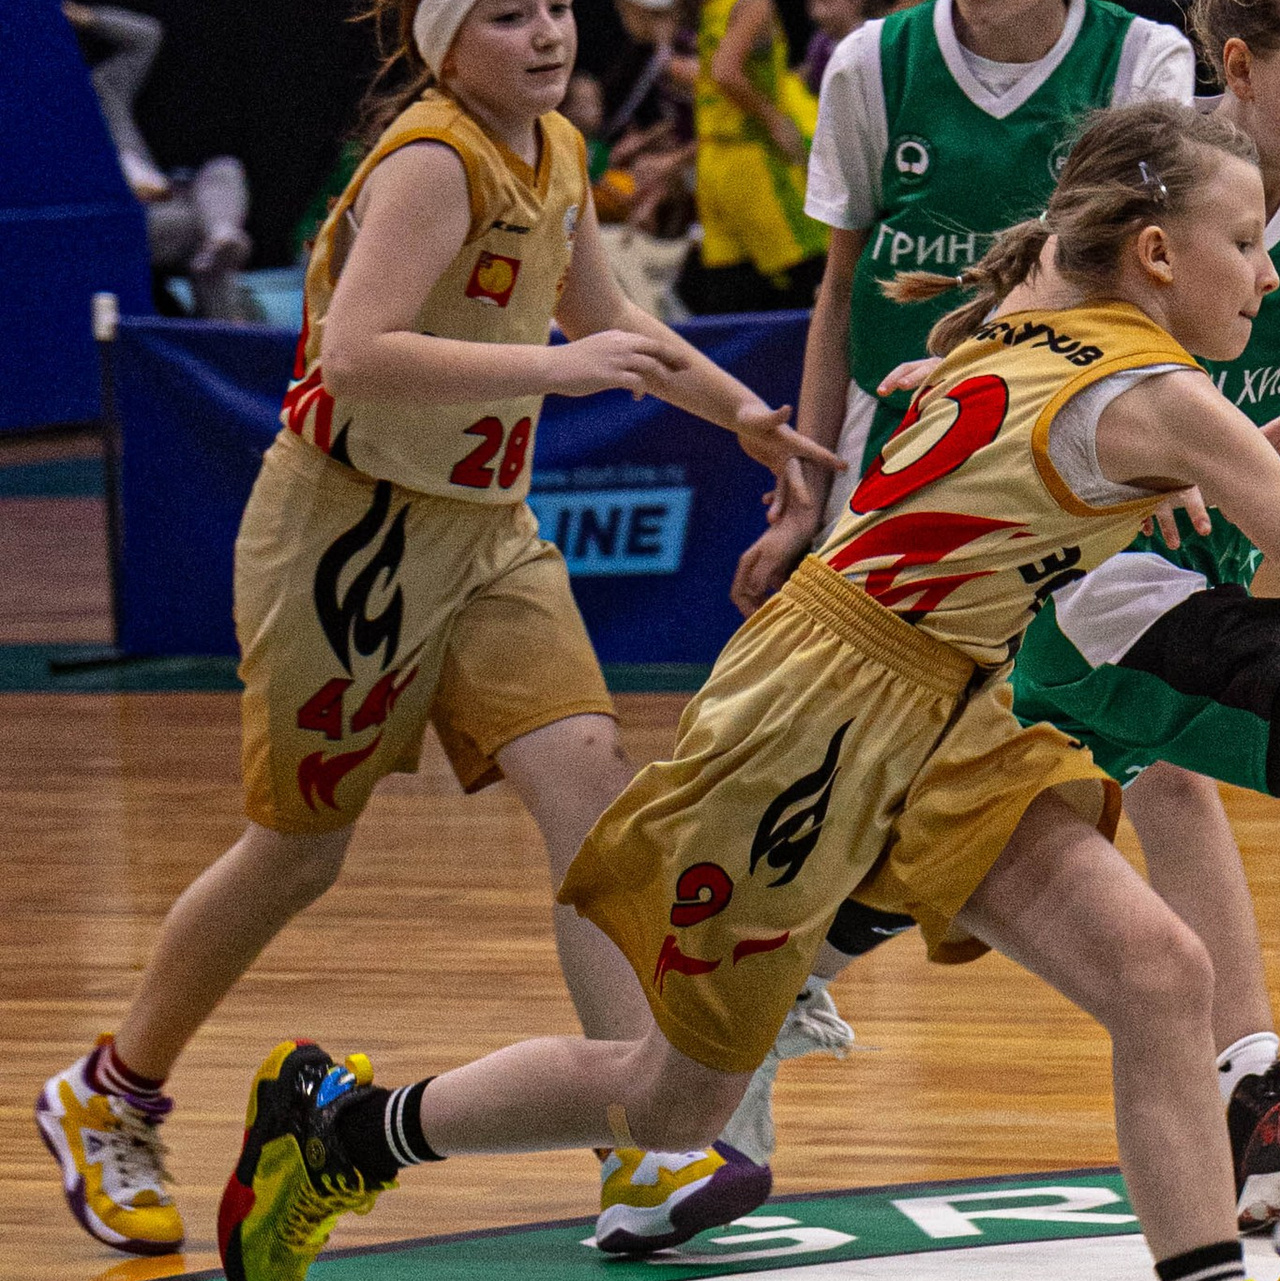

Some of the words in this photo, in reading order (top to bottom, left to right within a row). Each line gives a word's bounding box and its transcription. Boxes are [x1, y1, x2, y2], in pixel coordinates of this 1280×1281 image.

[872, 223, 976, 265] ГРИН
[450, 415, 532, 489] 28
[556, 502, 669, 558] INE
